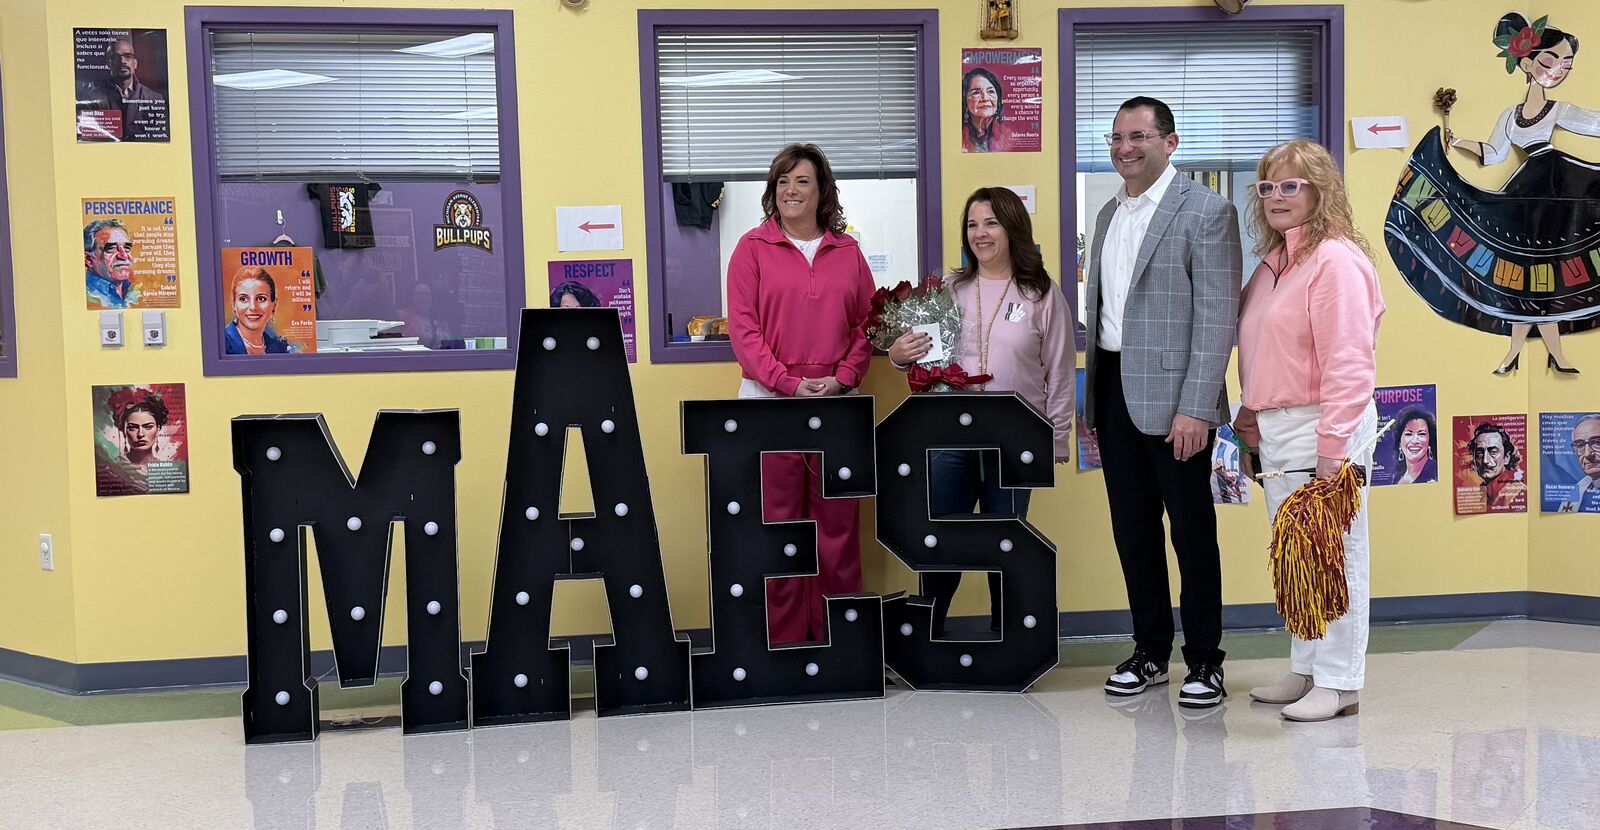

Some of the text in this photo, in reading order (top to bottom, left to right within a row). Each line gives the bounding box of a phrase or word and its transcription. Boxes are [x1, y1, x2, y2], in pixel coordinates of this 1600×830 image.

[85, 201, 173, 215] PERSEVERANCE
[436, 228, 490, 249] BULLPUPS
[241, 251, 292, 266] GROWTH
[564, 263, 616, 278] RESPECT
[1374, 388, 1423, 404] PURPOSE
[232, 307, 1060, 744] MAES
